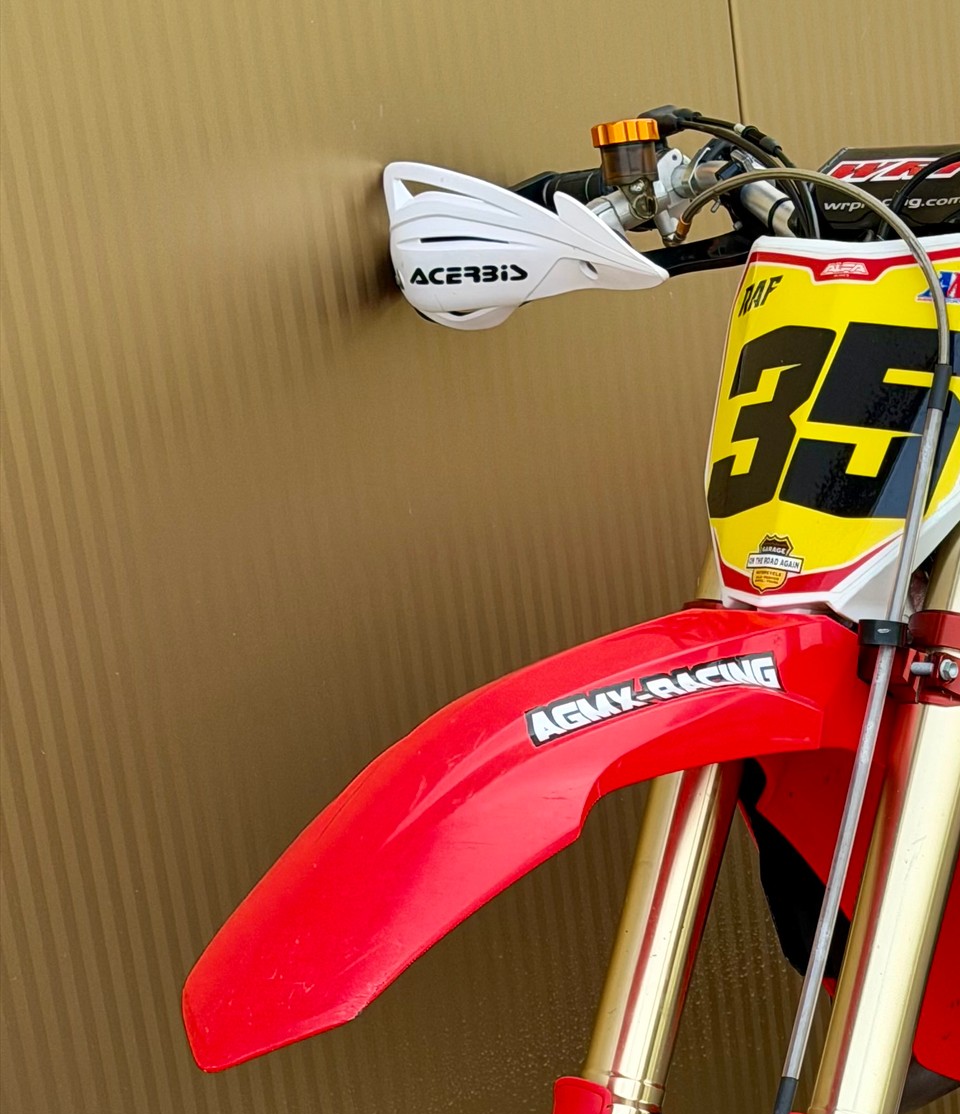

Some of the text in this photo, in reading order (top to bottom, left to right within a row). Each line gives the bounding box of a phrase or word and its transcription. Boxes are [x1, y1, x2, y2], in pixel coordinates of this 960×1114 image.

[738, 275, 784, 318] RAF
[780, 559, 801, 570] AGAIN
[531, 657, 782, 742] AGMX-RACING
